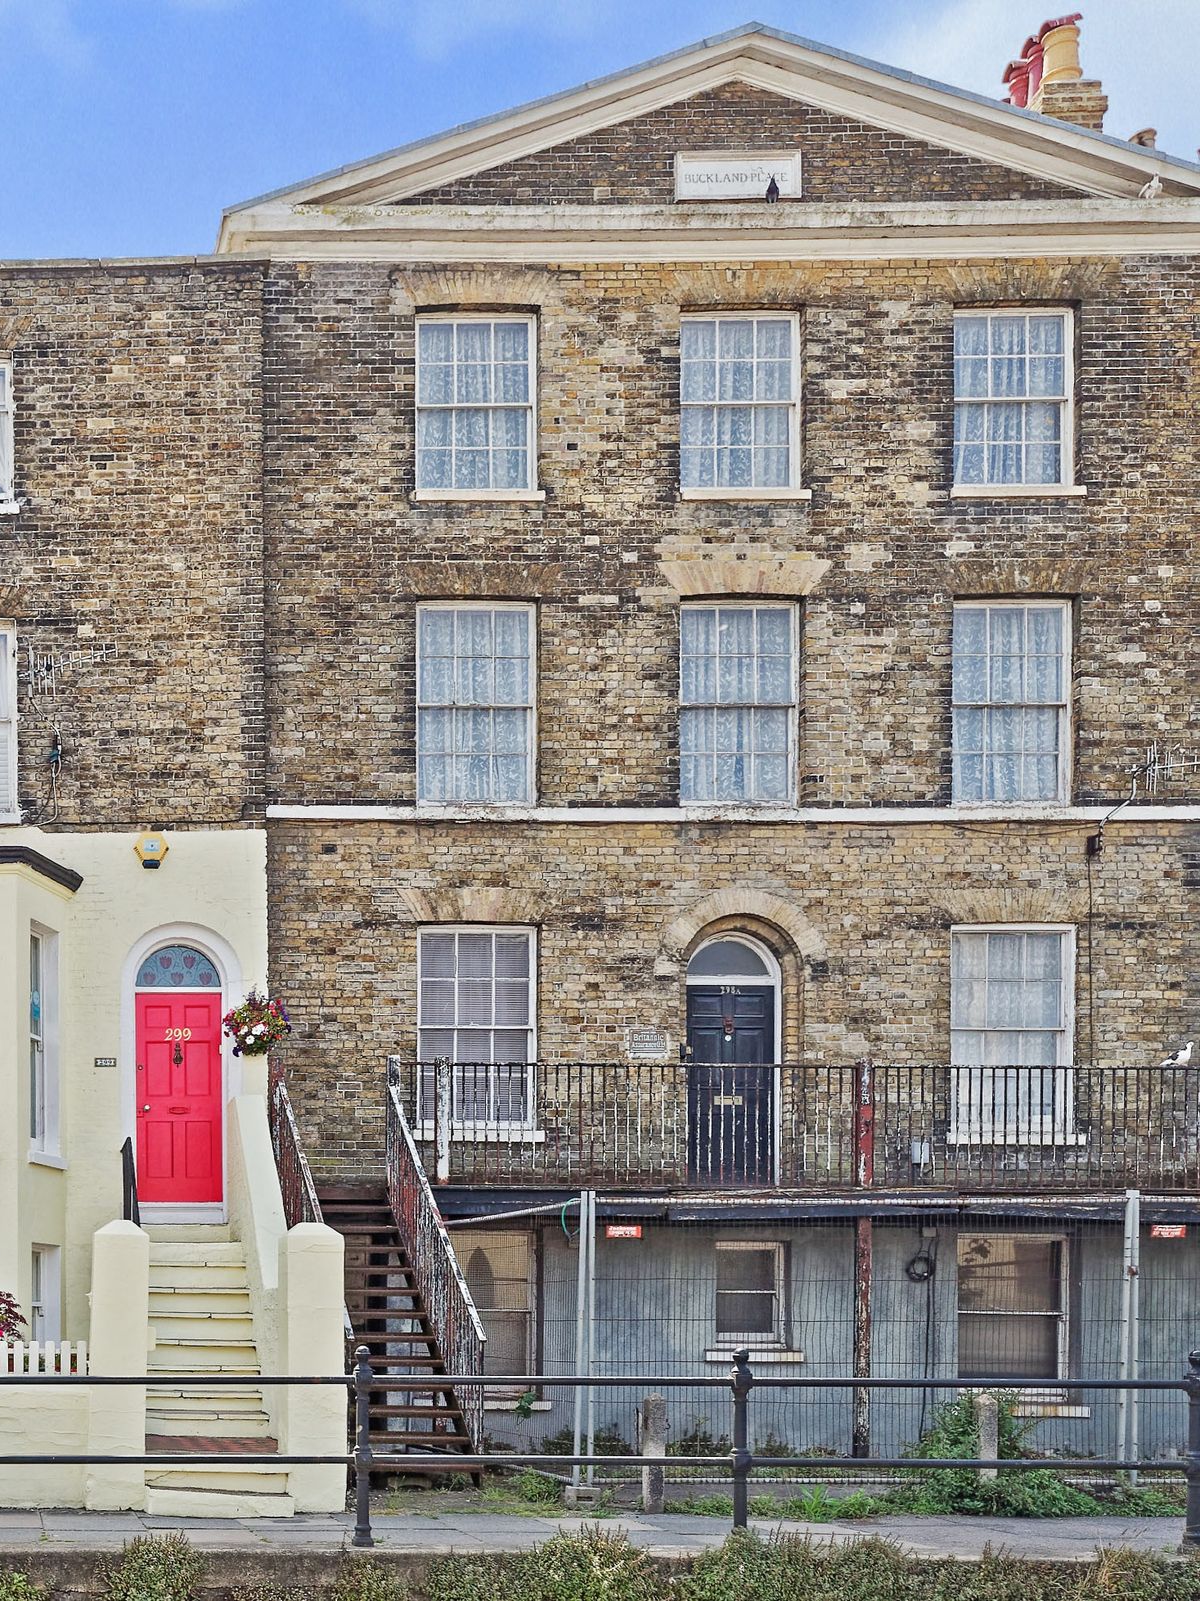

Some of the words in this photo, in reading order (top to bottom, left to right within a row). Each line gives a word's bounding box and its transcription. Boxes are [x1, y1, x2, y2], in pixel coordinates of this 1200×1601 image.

[684, 173, 748, 184] BUCKLAND
[750, 172, 789, 183] PLACE
[164, 1027, 192, 1042] 299
